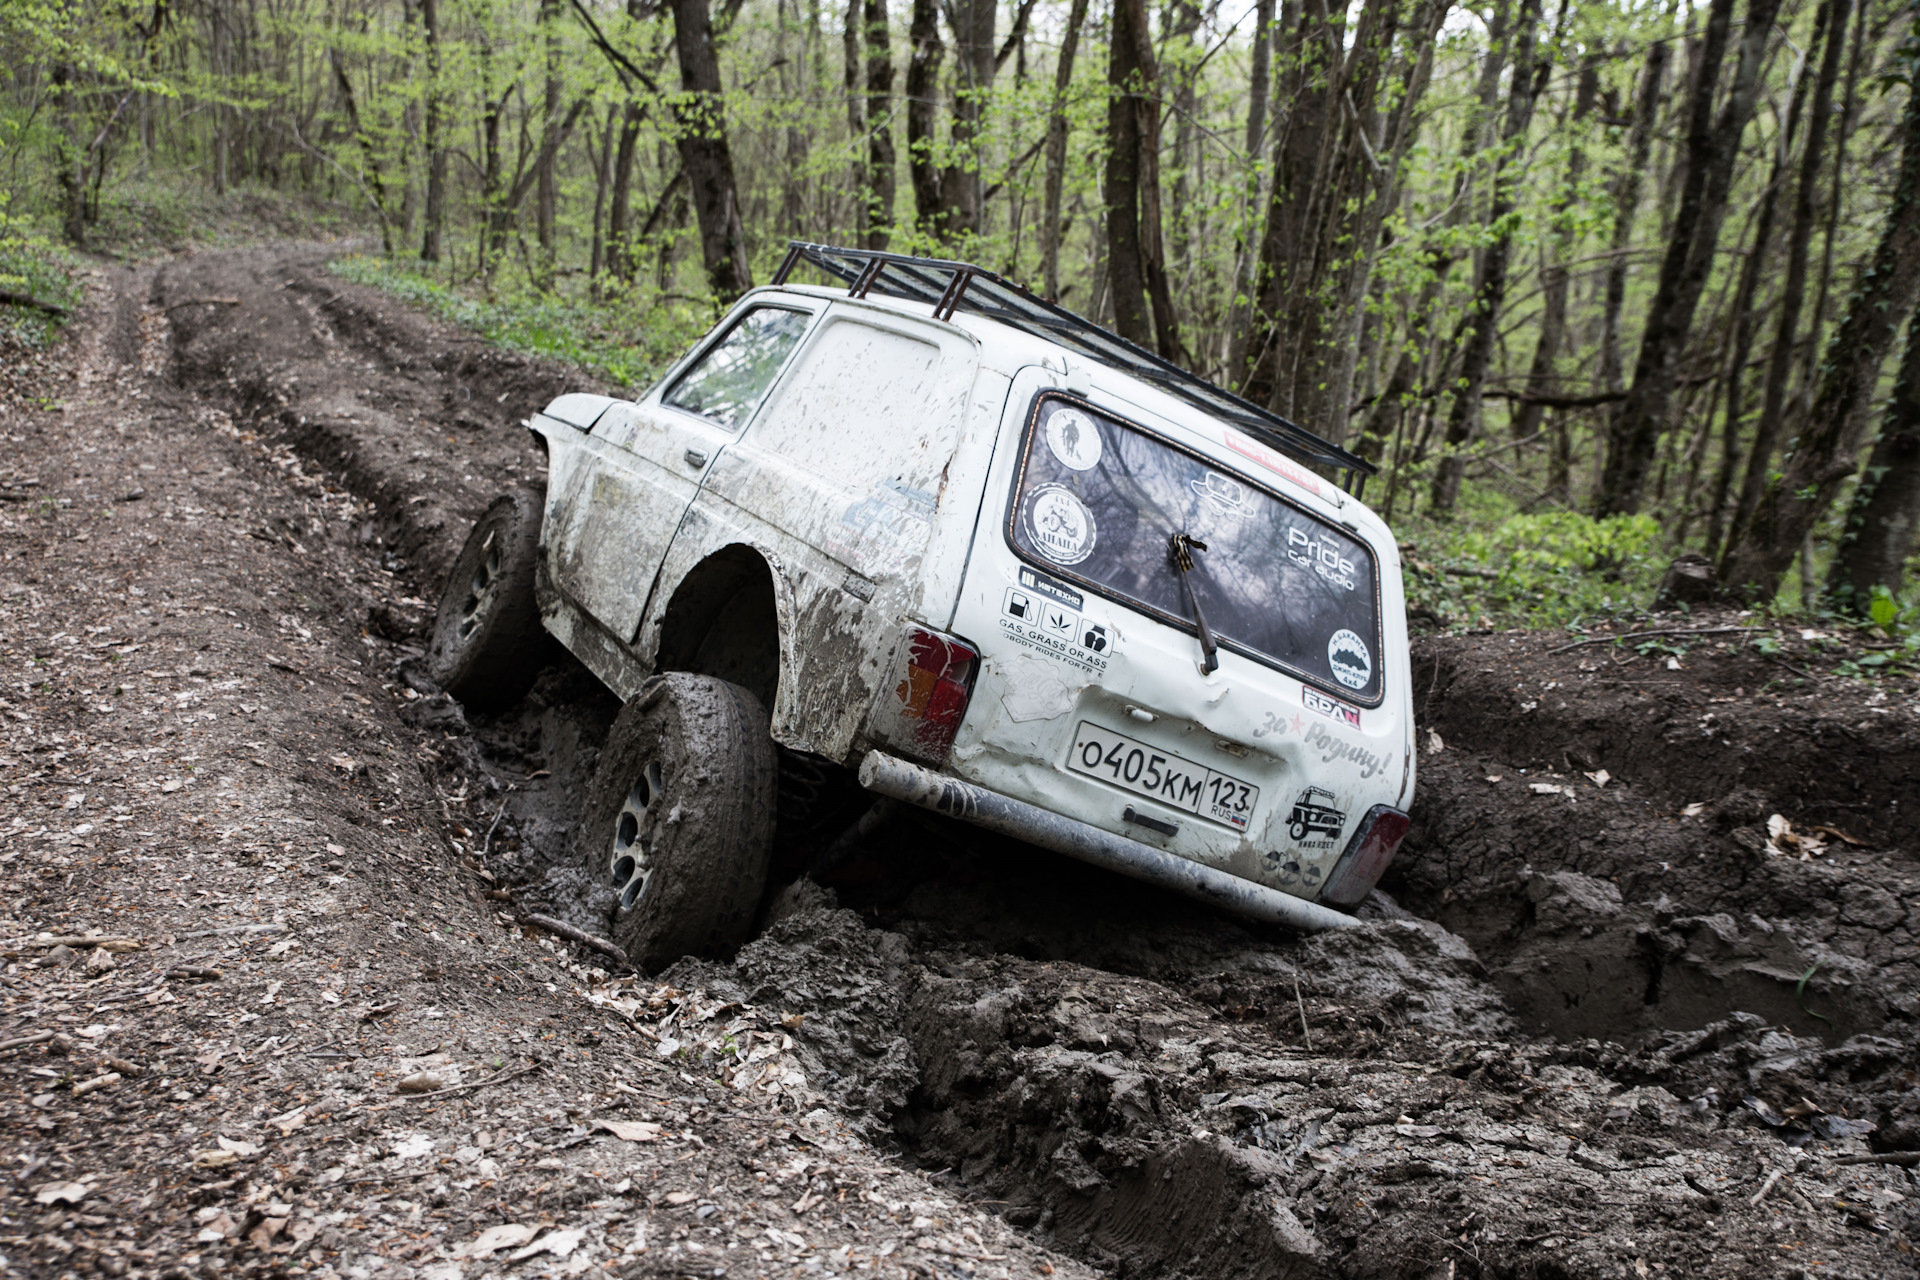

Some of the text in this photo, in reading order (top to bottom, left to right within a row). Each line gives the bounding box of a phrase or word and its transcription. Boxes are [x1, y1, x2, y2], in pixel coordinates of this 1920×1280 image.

[1288, 526, 1355, 576] Pride
[1288, 549, 1355, 591] car audio
[999, 618, 1108, 669] GAS, GRASS OR ASS
[1003, 632, 1104, 679] OBODY RIDES FOR FRE
[1252, 711, 1393, 779] За Родину!
[1209, 777, 1250, 812] 123
[1210, 805, 1232, 820] RUS
